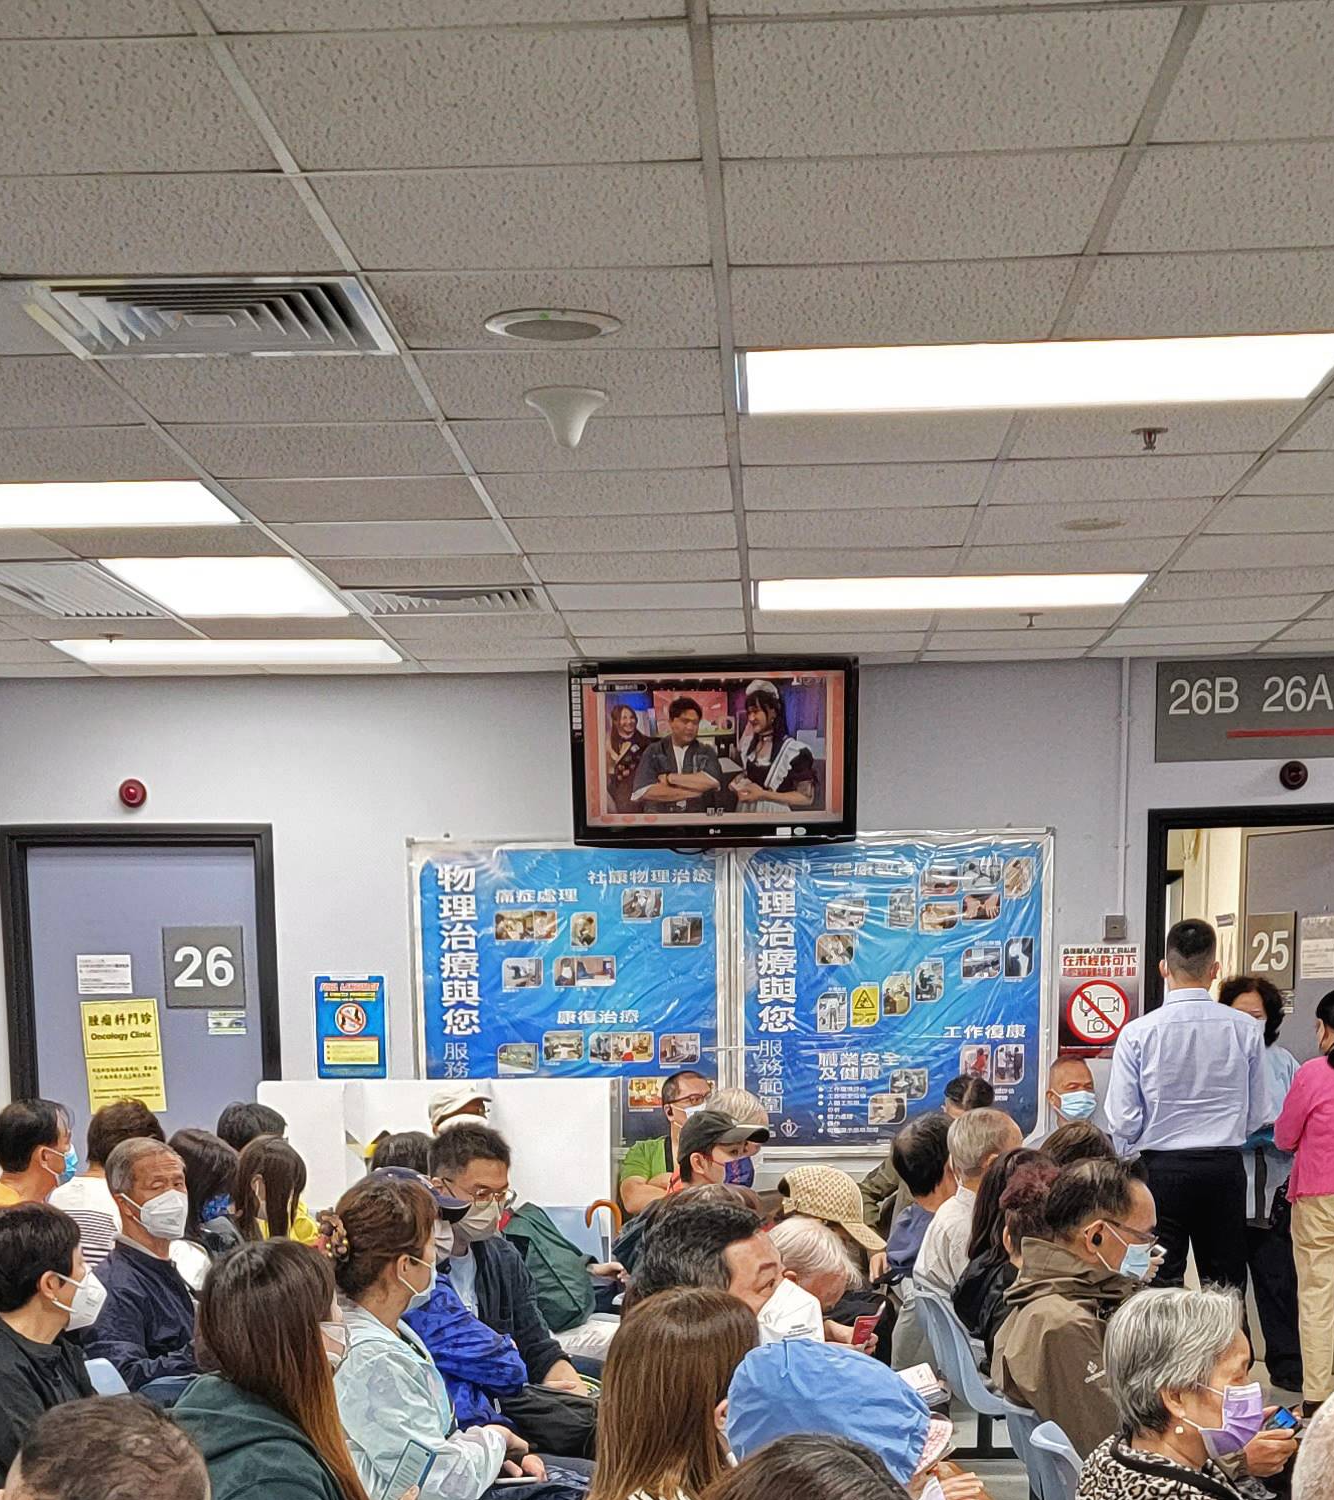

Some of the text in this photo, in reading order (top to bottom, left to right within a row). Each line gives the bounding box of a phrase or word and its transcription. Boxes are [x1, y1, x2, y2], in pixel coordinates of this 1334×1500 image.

[1168, 675, 1240, 716] 26B
[1262, 674, 1334, 713] 26A
[495, 888, 579, 904] 痛症處理
[757, 862, 797, 1032] 物理治療與您
[1250, 930, 1290, 973] 25
[173, 946, 235, 987] 26
[1063, 954, 1137, 967] 在未經許可下
[437, 864, 483, 1079] 物理治療與您 服務
[88, 1012, 153, 1027] 腫瘤科門診
[557, 1010, 640, 1025] 康復治療
[91, 1030, 152, 1041] Oncology Clinic
[943, 1024, 1026, 1040] 工作復康
[818, 1051, 900, 1067] 職業安全
[818, 1066, 881, 1081] 及健康
